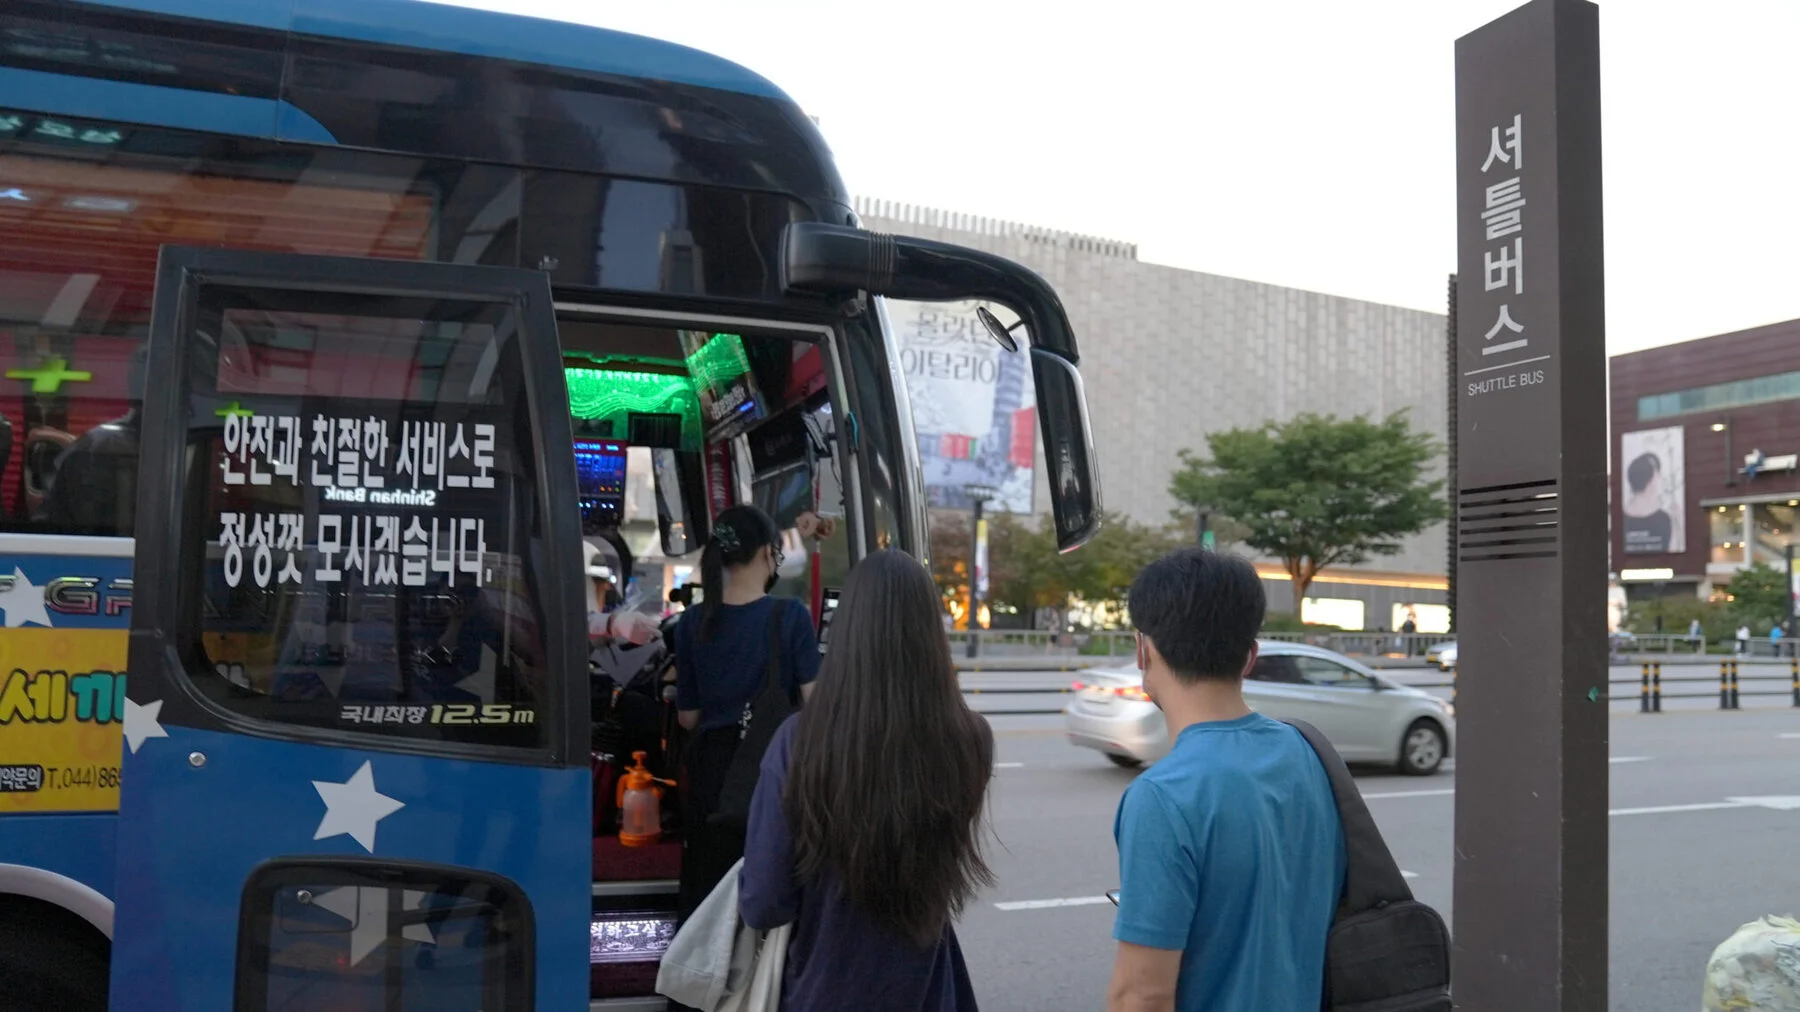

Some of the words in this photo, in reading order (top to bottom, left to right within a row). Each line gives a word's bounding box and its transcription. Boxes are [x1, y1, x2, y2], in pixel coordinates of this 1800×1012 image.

[1481, 113, 1528, 356] 셔틀버스
[901, 347, 1003, 385] 이탈리아
[1468, 375, 1517, 396] SHUTTLE
[1520, 370, 1544, 386] BUS
[223, 412, 303, 487] 안전과
[311, 413, 389, 488] 친절한
[396, 420, 495, 491] 서비스로
[219, 512, 304, 588] 정성껏
[315, 514, 493, 588] 모시겠습니다.
[0, 767, 42, 791] 약문의
